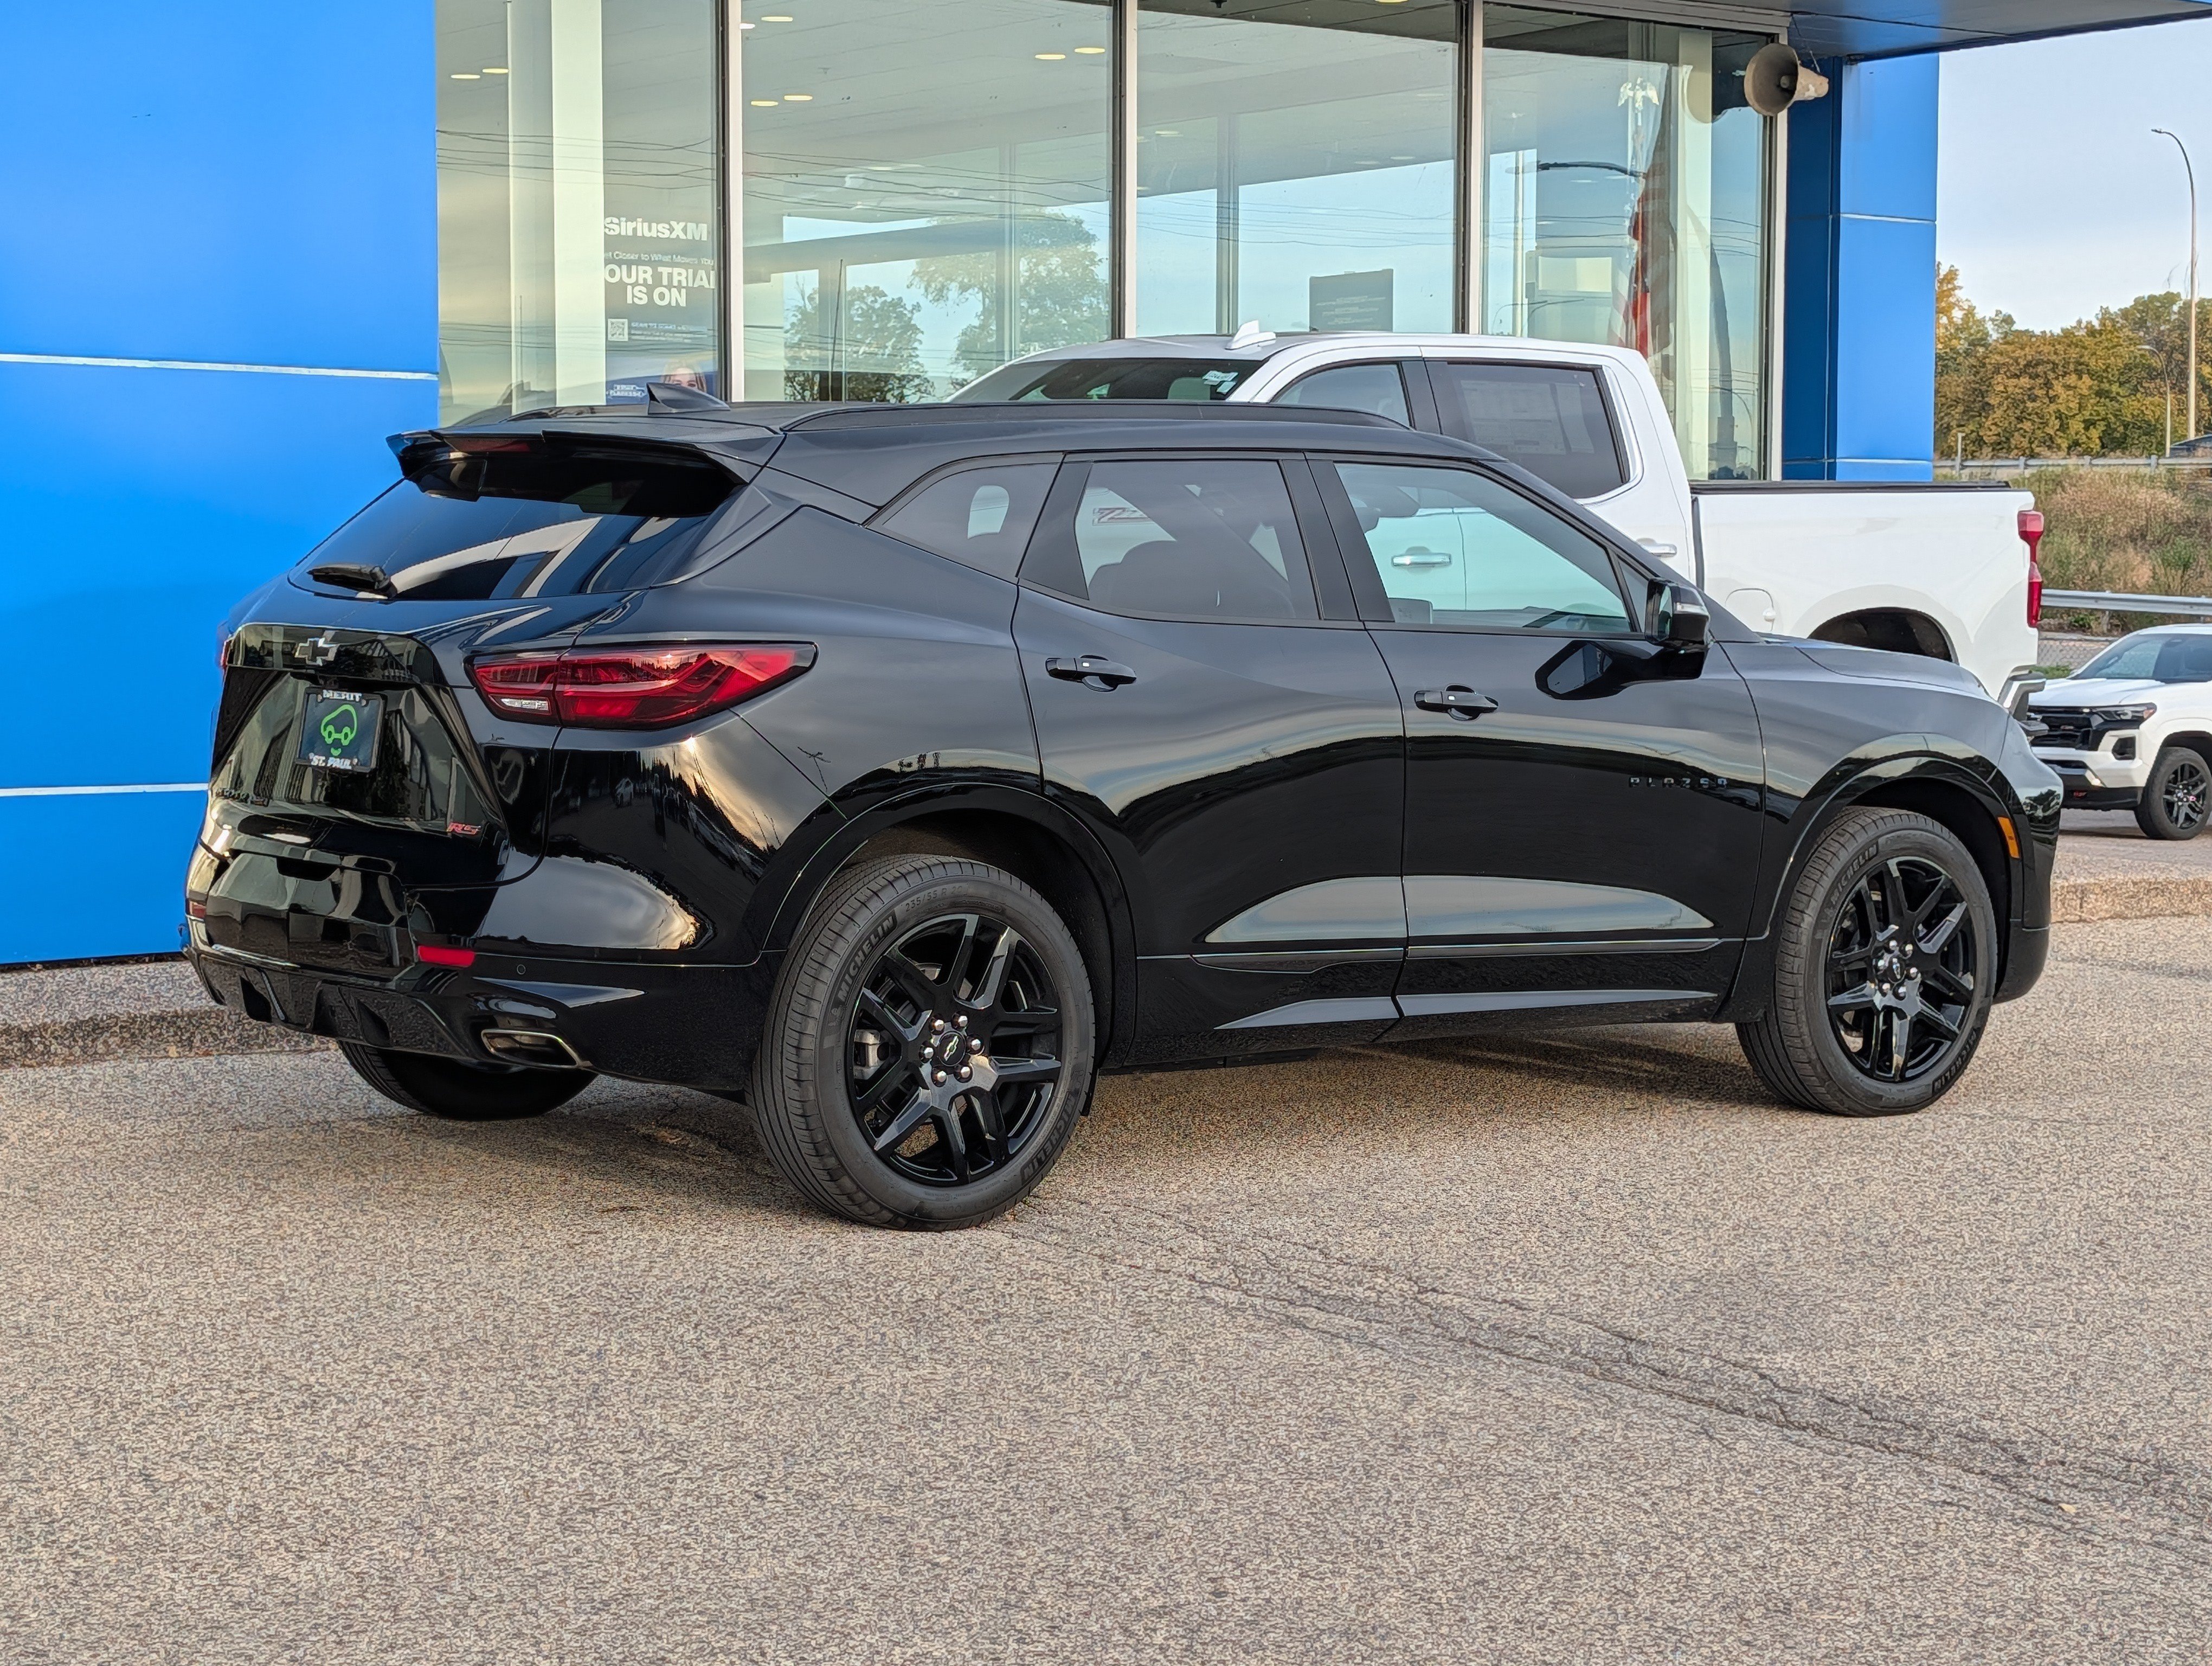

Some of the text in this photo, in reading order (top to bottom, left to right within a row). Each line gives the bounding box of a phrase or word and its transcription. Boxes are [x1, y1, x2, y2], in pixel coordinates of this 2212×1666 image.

[604, 216, 708, 241] SiriusXM
[605, 264, 653, 285] OUR
[627, 285, 686, 306] IS ON
[446, 822, 481, 835] RS
[905, 890, 937, 913] 235/55
[838, 915, 895, 1002] MICHELIN
[1023, 1093, 1076, 1181] MICHELIN
